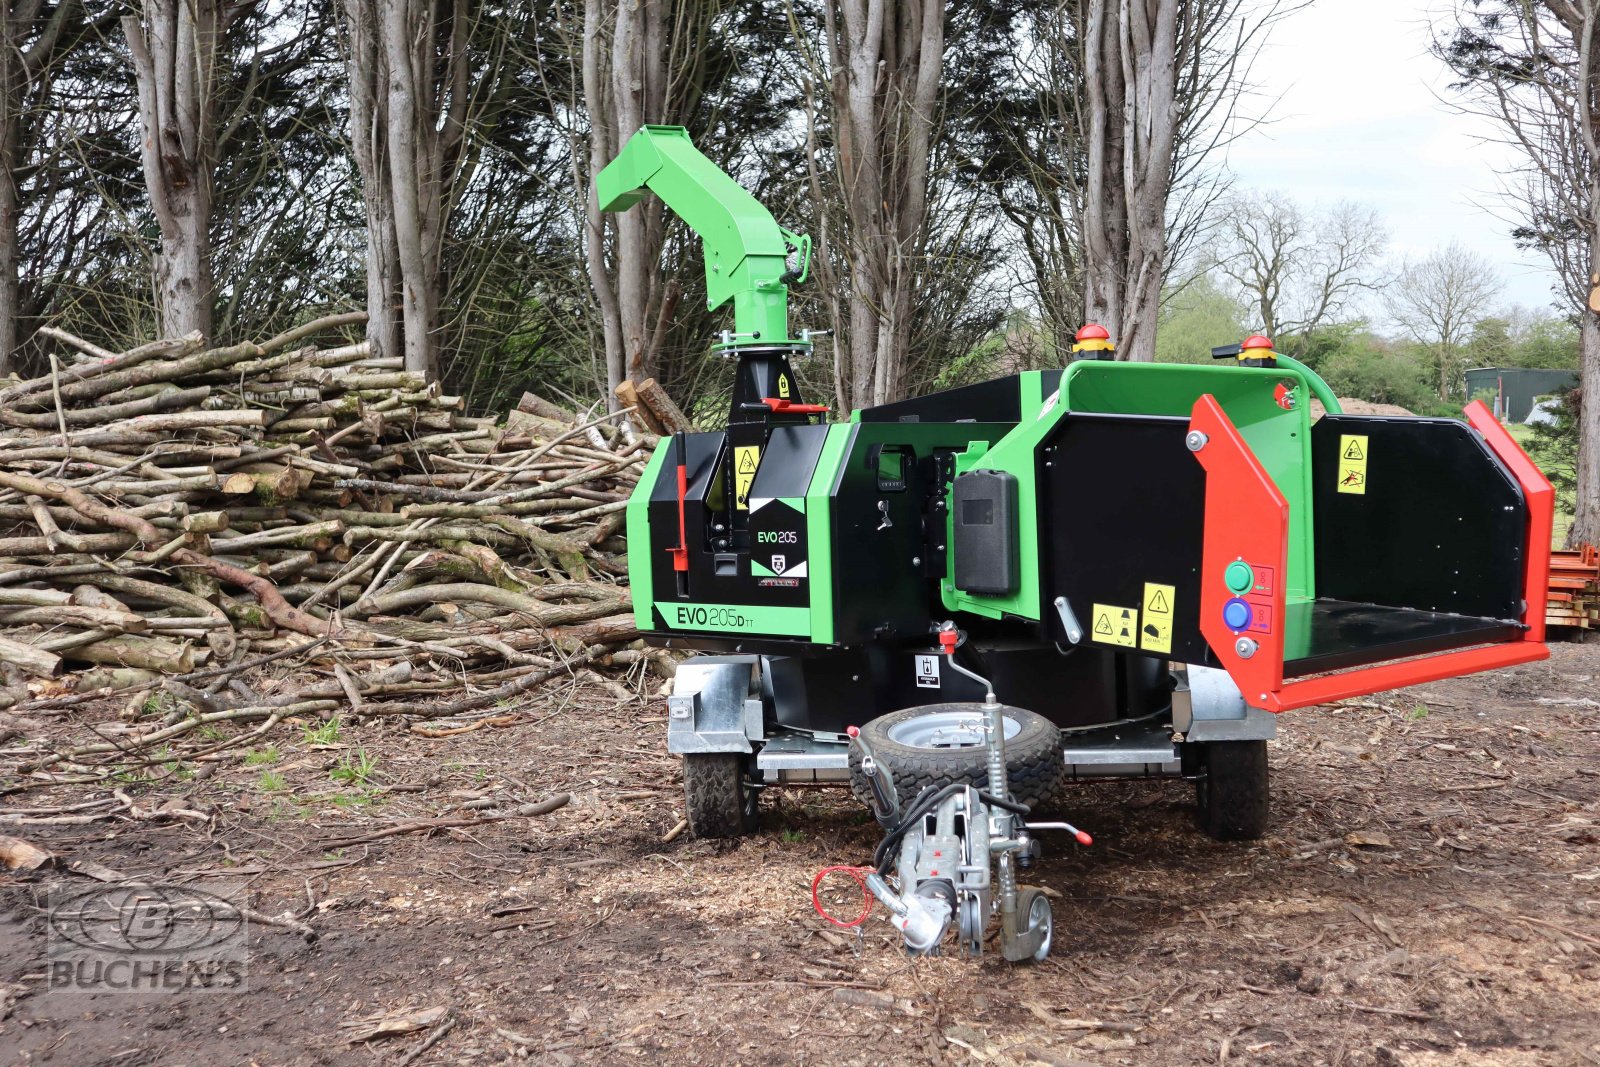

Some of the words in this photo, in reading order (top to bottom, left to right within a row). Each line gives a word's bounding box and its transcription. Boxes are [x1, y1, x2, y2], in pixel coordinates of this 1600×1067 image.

[757, 531, 778, 543] EVO
[778, 531, 798, 544] 205
[677, 606, 707, 626] EVO
